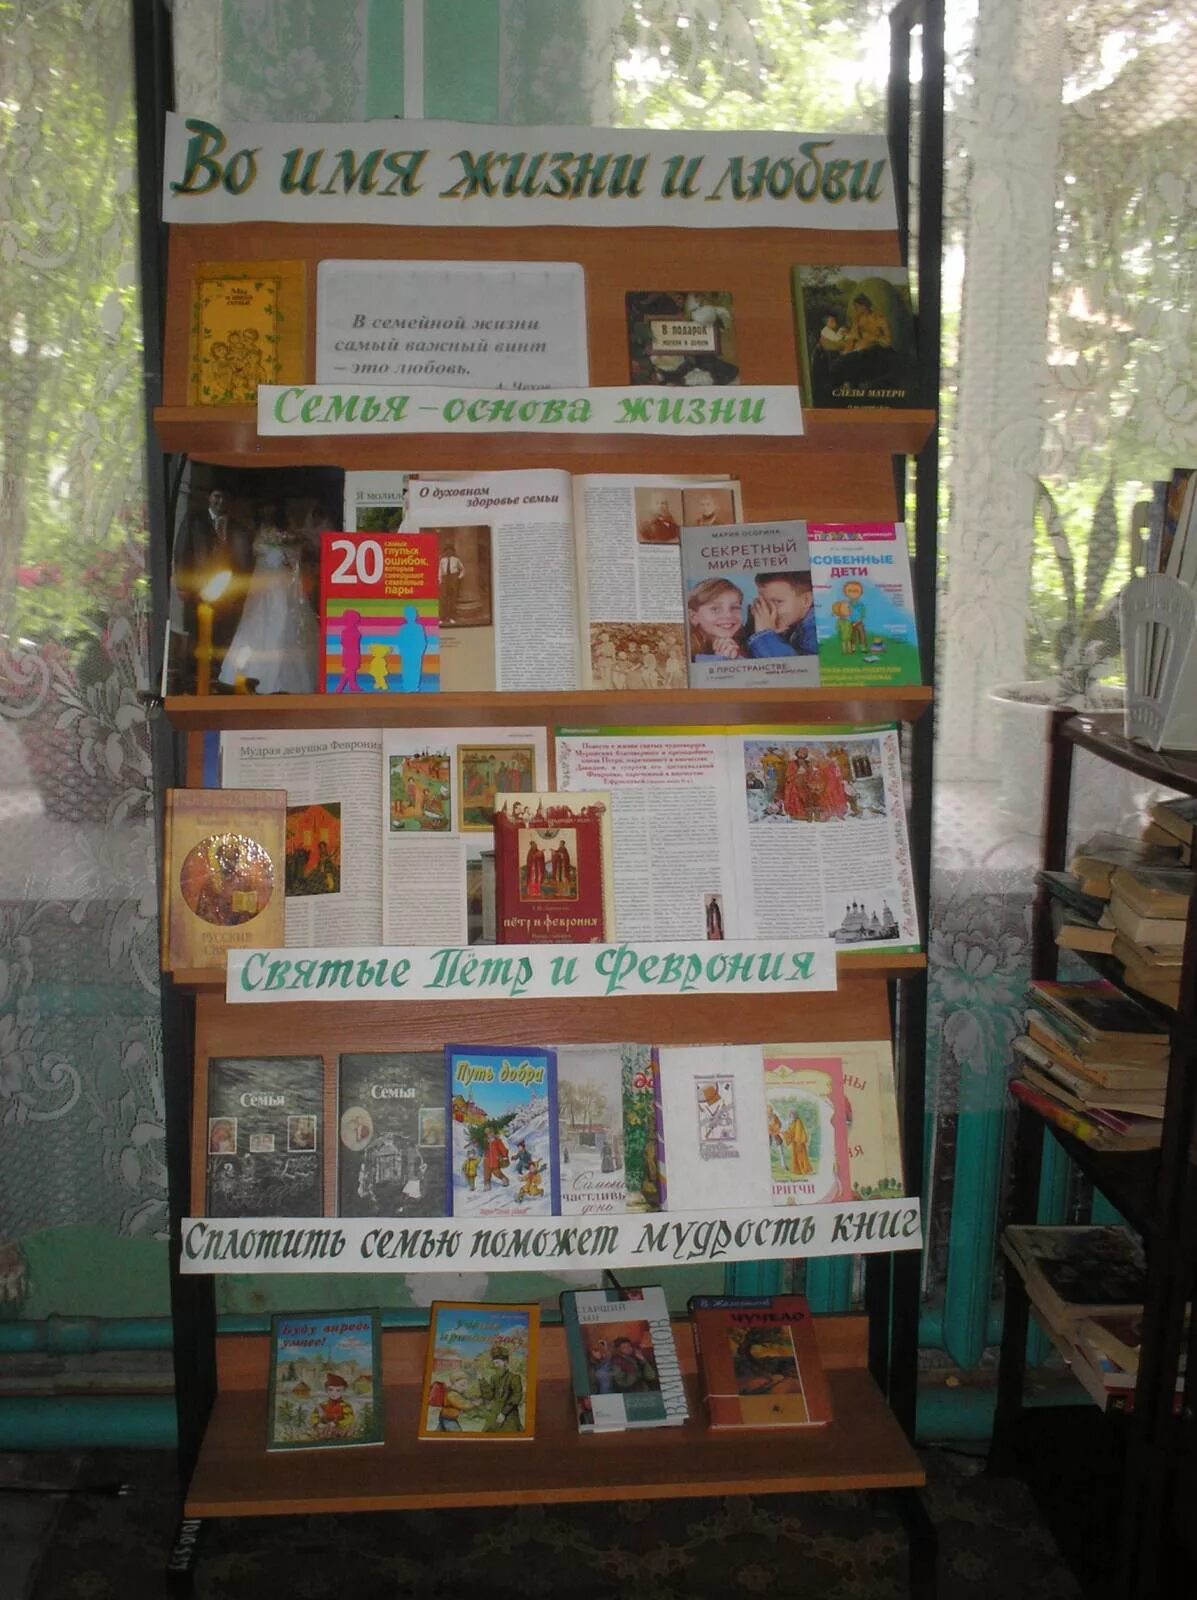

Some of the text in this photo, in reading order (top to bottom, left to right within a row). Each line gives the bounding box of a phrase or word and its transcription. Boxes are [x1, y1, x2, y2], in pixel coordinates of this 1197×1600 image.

[169, 118, 888, 203] Во имя жизни и любви
[352, 314, 540, 331] В семейной жизни
[672, 325, 707, 336] подарок
[334, 337, 547, 353] самый важный винт
[352, 362, 389, 375] это
[394, 360, 471, 375] любовь.
[273, 387, 410, 425] Семья
[442, 396, 592, 424] основа
[613, 396, 767, 425] жизни
[419, 486, 490, 501] О духовном
[466, 494, 559, 509] здоровье семьи
[700, 538, 797, 558] СЕКРЕТНЫЙ
[330, 539, 383, 584] 20
[384, 555, 429, 567] ошибок,
[708, 553, 788, 571] МИР ДЕТЕЙ
[809, 554, 894, 565] СОБЕННЫЕ
[830, 566, 868, 578] ДЕТИ
[384, 586, 414, 597] пары
[716, 663, 787, 673] ПРОСТРАНСТВЕ
[240, 745, 281, 758] Мудрая
[282, 743, 328, 756] девушка
[240, 943, 816, 996] Святые Пётр и Феврония
[456, 1060, 545, 1086] Путь добра
[370, 1084, 416, 1099] Семья
[240, 1092, 285, 1107] Семья
[184, 1207, 921, 1261] Сплотить семью поможет мудрость книг
